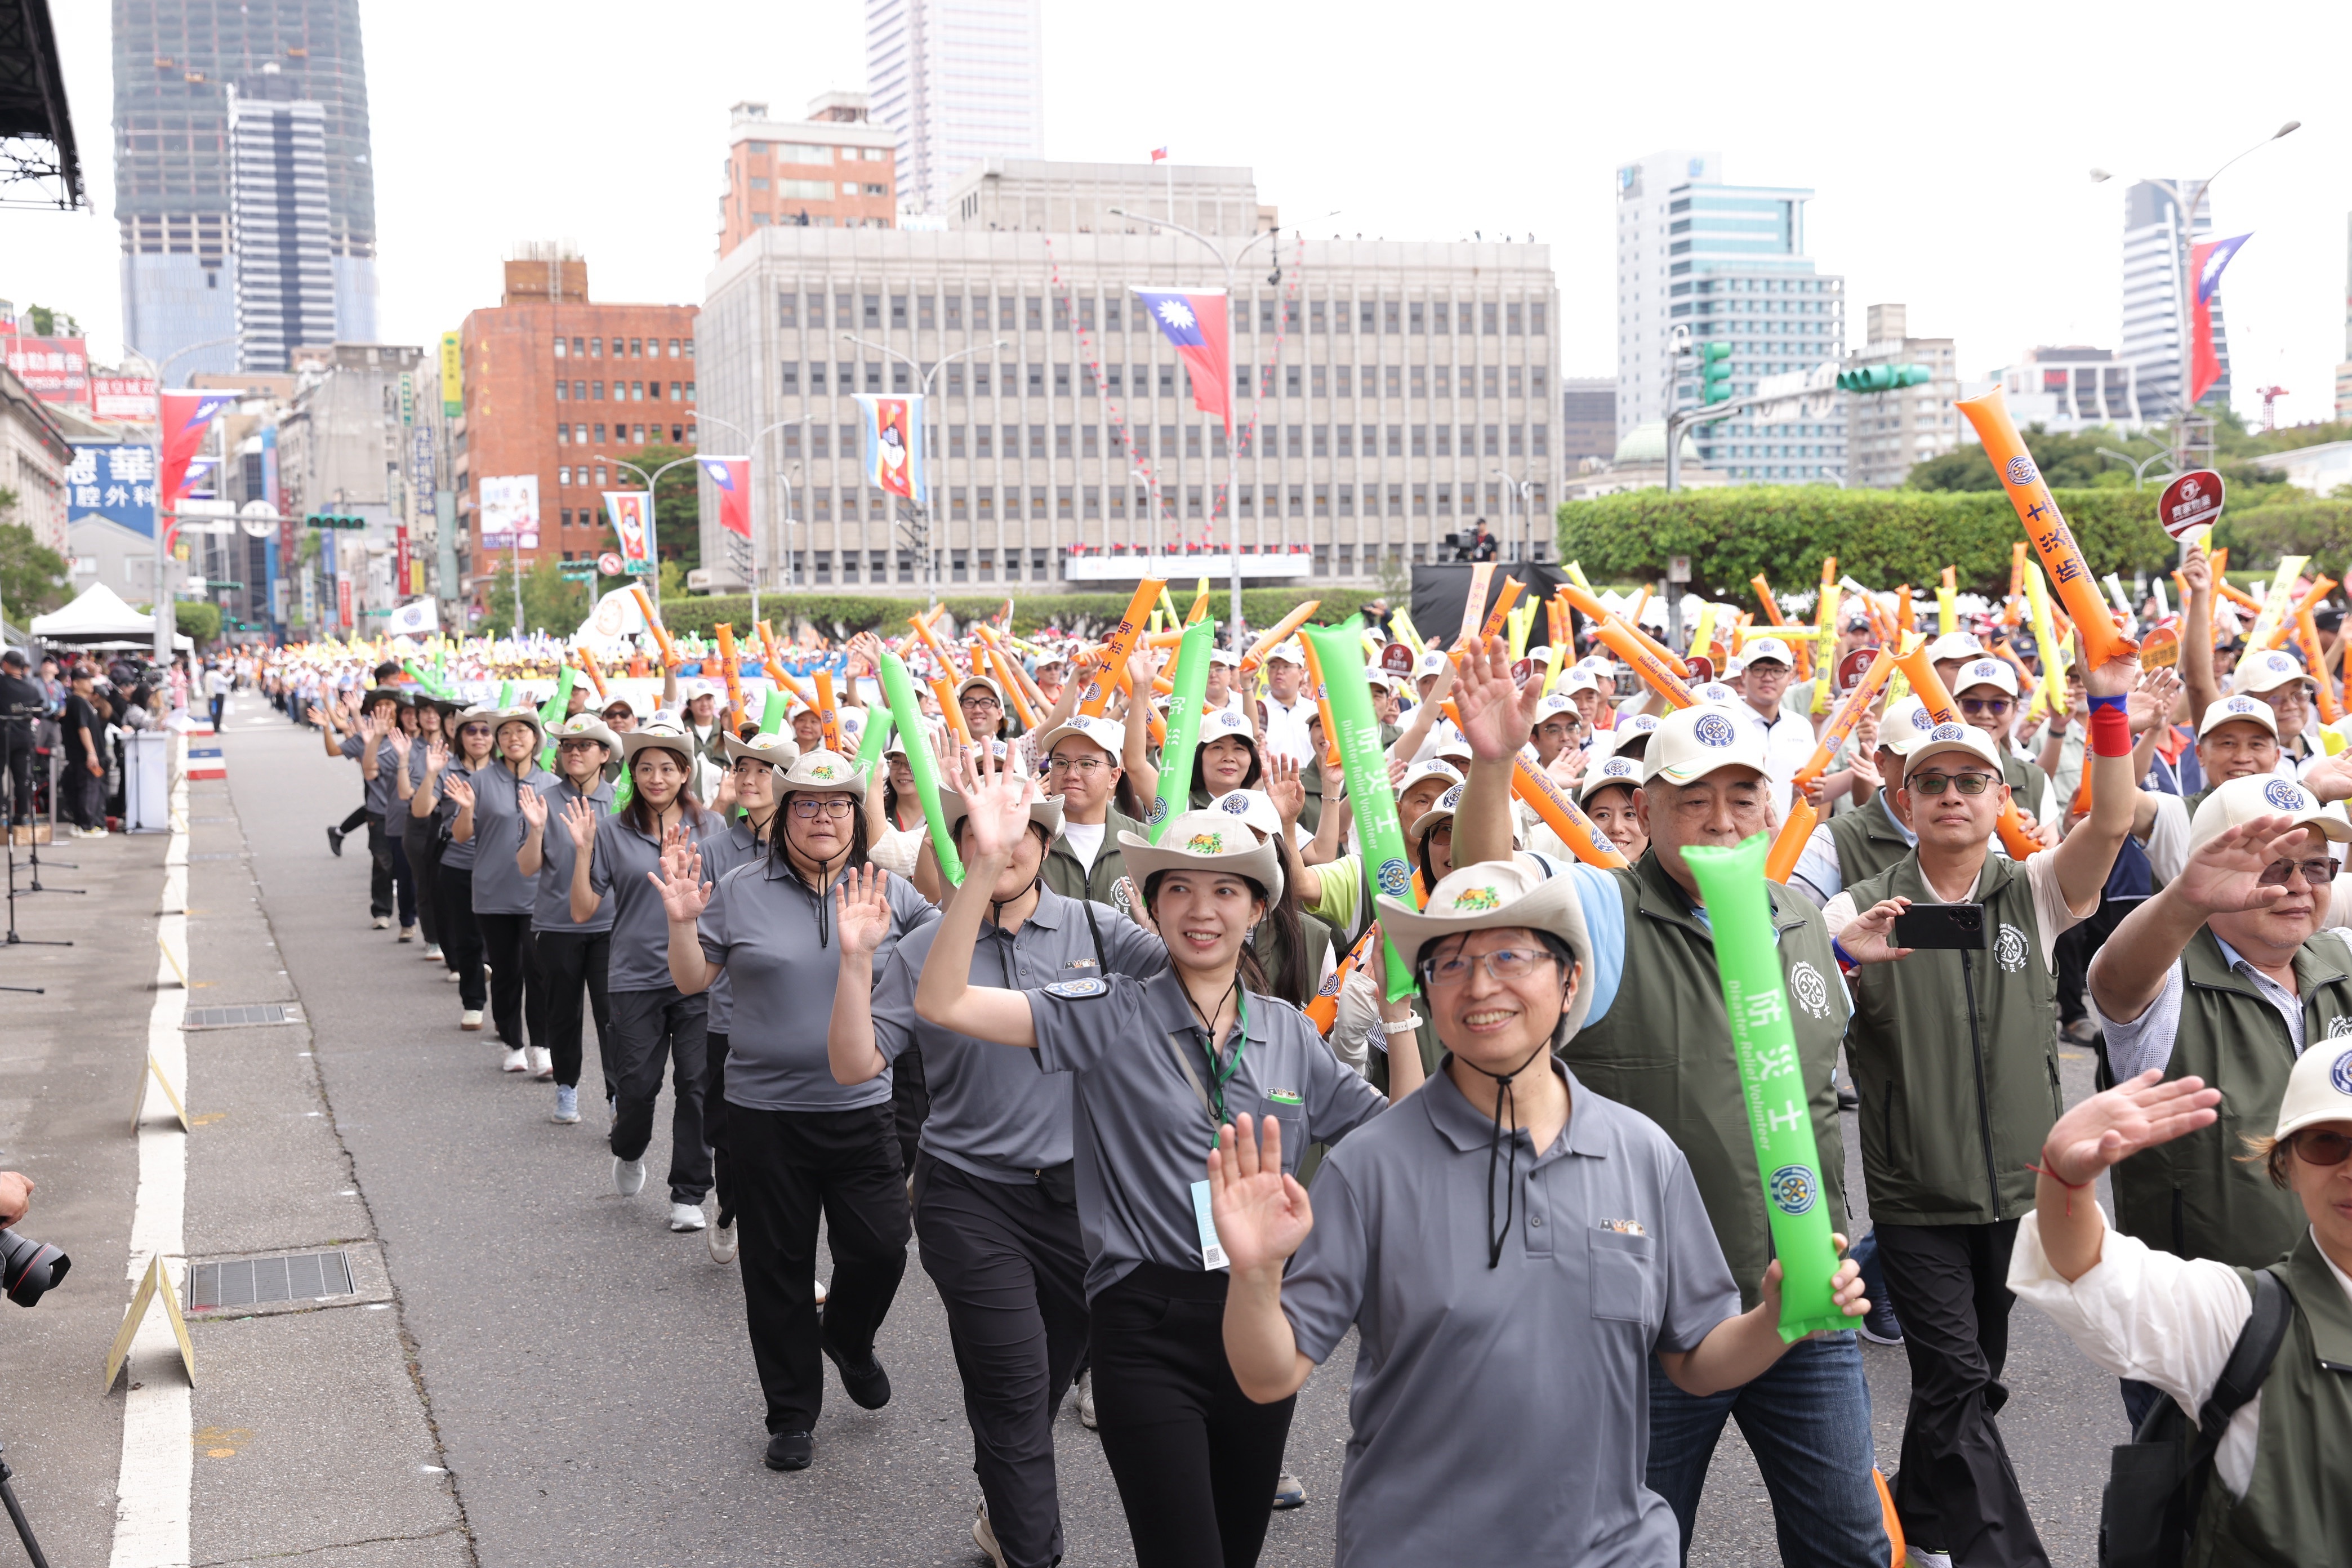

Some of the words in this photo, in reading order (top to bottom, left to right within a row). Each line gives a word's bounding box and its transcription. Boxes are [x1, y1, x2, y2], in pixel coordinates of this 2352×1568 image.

[2042, 489, 2064, 527] Volunteer
[2027, 500, 2082, 585] 防災士
[2060, 525, 2077, 550] Relief
[2073, 551, 2093, 583] Disaster
[1099, 621, 1134, 674] 防災士
[1637, 656, 1658, 675] Disaster
[1656, 672, 1672, 687] Relief
[1671, 684, 1694, 707] Volunteer
[910, 707, 924, 736] Disaster
[919, 736, 930, 757] Relief
[925, 757, 939, 789] Voluntee
[1341, 719, 1359, 764] Disaster
[1352, 765, 1367, 796] Relief
[1355, 725, 1398, 834] 防災士
[1514, 755, 1534, 774] aster
[1530, 772, 1552, 795] Relief
[1549, 791, 1583, 827] Volunteer
[1358, 796, 1378, 849] Volunteer
[2007, 924, 2028, 943] Volunteer
[1726, 980, 1748, 1039] Disaster
[1798, 998, 1830, 1019] 防災士
[1739, 1040, 1759, 1082] Relief
[1745, 988, 1804, 1133] 防災士
[1748, 1083, 1771, 1152] Volunteer
